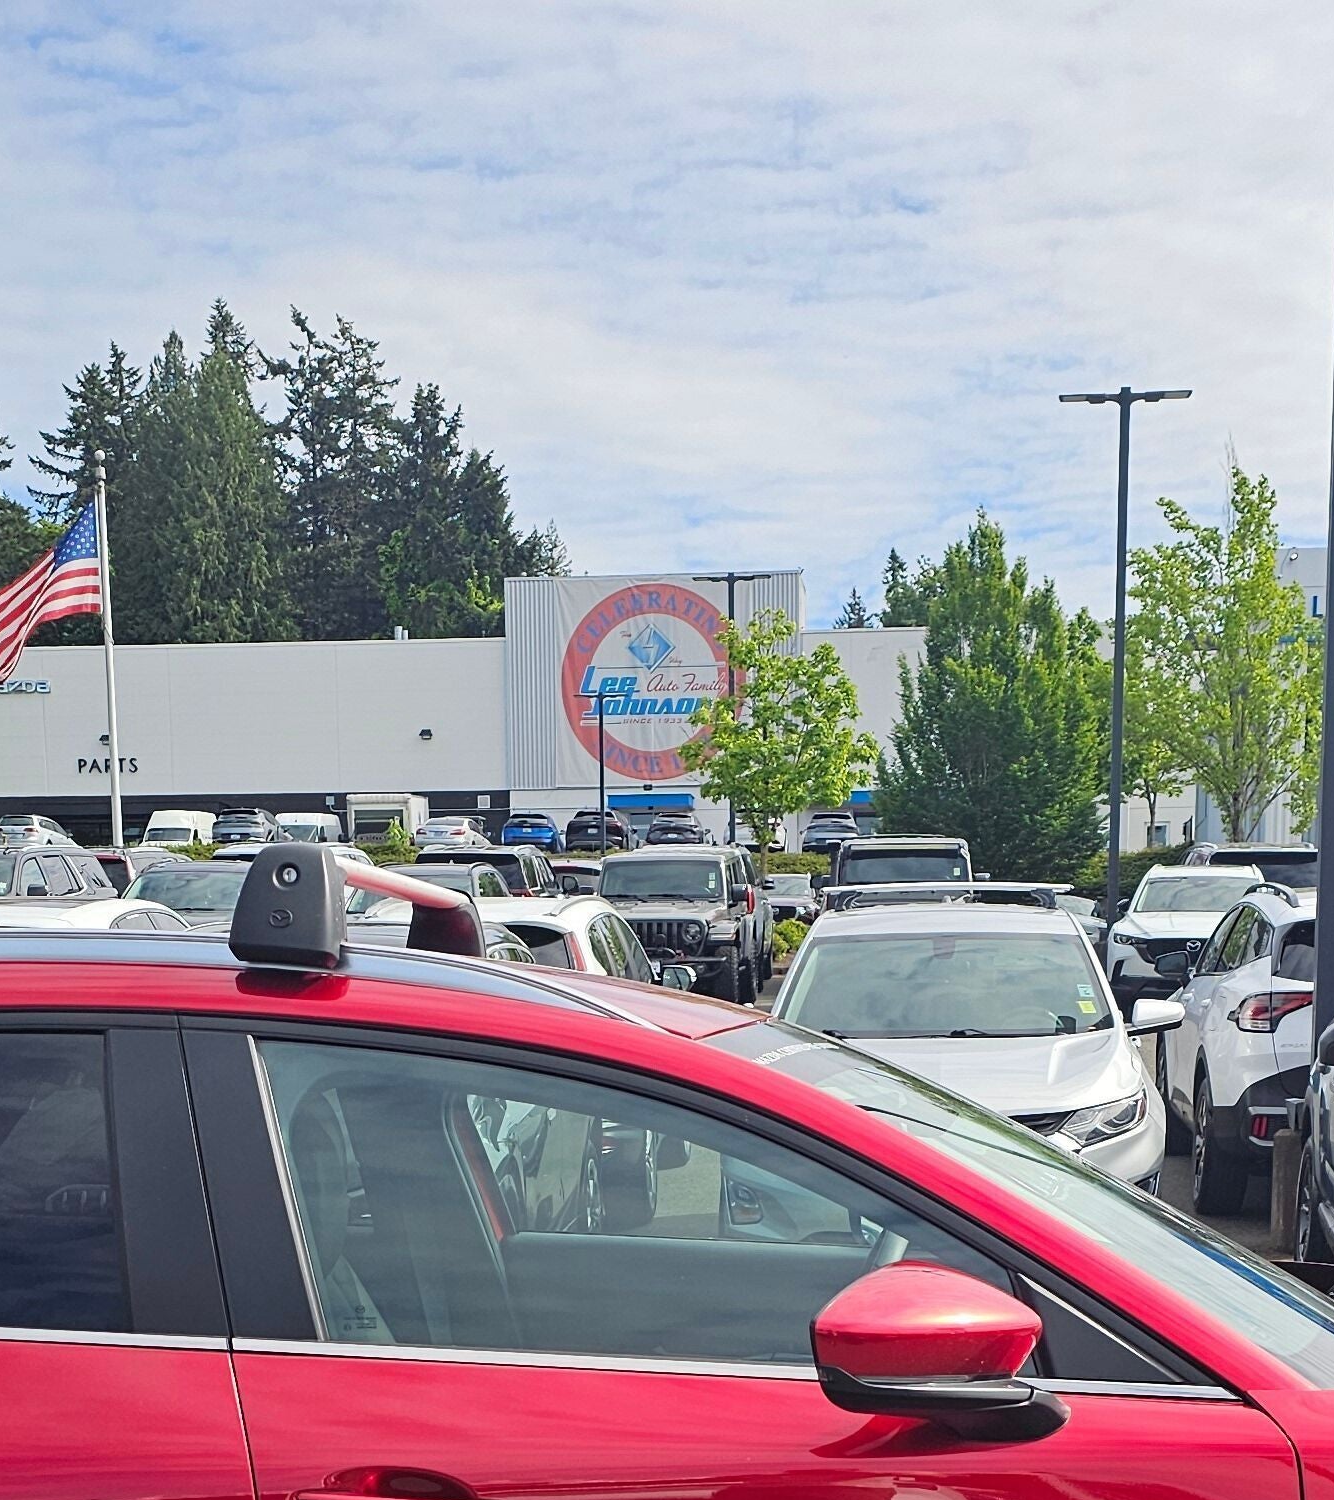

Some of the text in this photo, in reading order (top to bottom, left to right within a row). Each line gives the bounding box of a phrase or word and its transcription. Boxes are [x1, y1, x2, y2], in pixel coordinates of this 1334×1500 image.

[576, 590, 726, 654] CELEBRATIN
[580, 665, 729, 695] Lee Auto Family
[601, 742, 663, 773] INCE
